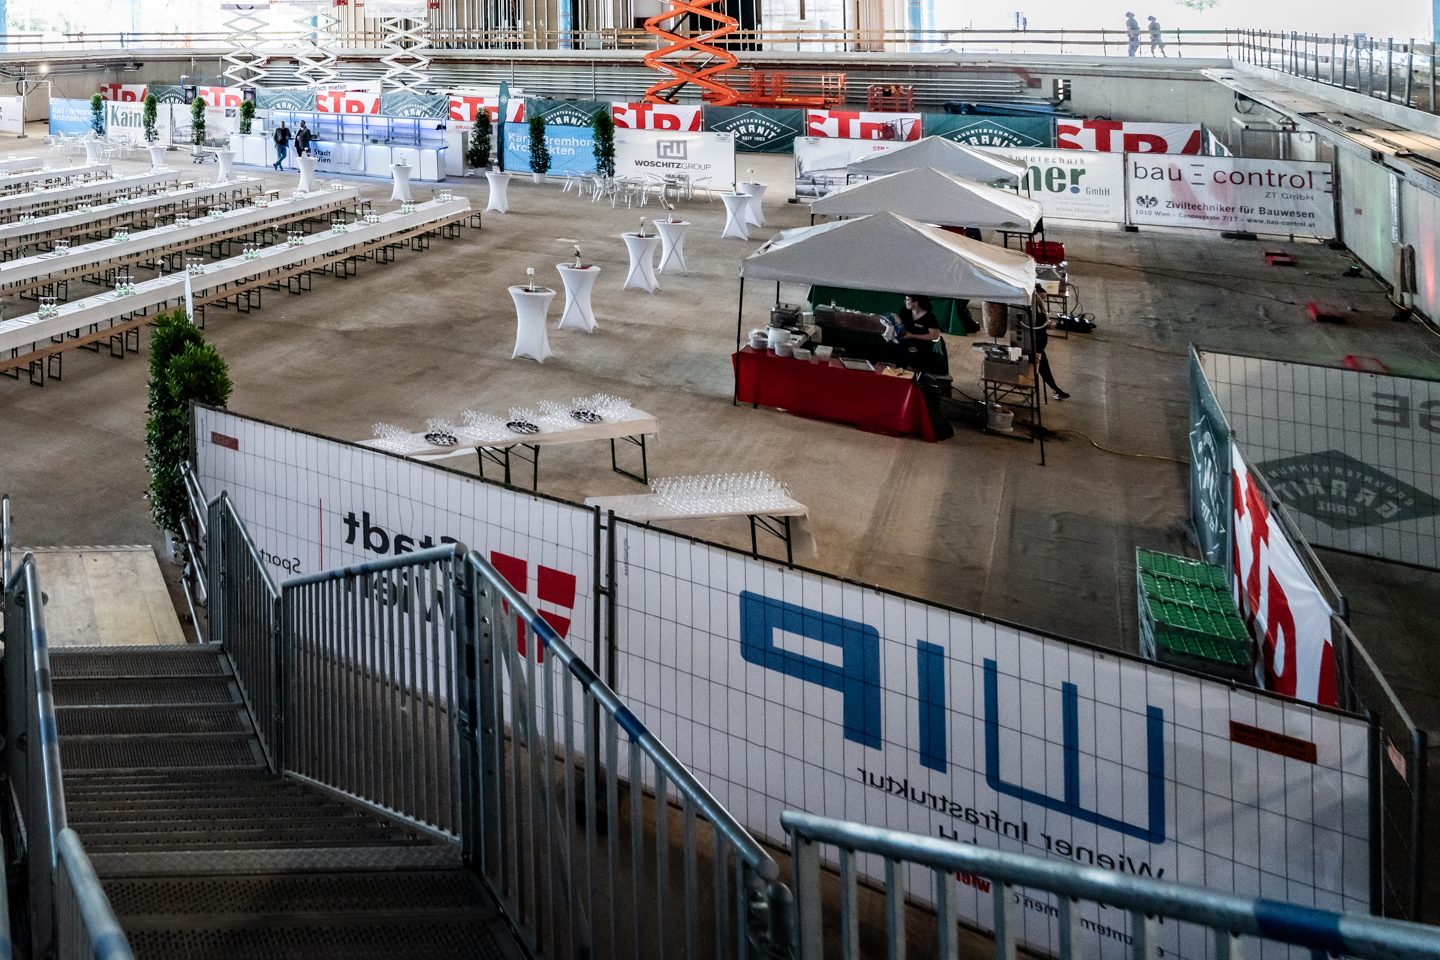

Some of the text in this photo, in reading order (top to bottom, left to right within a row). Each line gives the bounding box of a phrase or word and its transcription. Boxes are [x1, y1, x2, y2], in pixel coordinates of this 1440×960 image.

[200, 87, 242, 107] STR
[52, 106, 64, 114] Karl
[111, 105, 144, 127] Kain
[450, 97, 524, 122] STR
[508, 133, 596, 147] Kar Bremhor
[508, 142, 575, 155] Arckten
[634, 160, 711, 170] WOSCHITZGROUP
[1134, 161, 1313, 189] bau control
[1086, 187, 1110, 196] GmbH
[1281, 192, 1314, 201] GmbH
[1166, 200, 1315, 219] Ziviltechniker für Bauwesen
[1179, 212, 1220, 221] Canovagasse
[1247, 217, 1315, 228] www.bau-control.at
